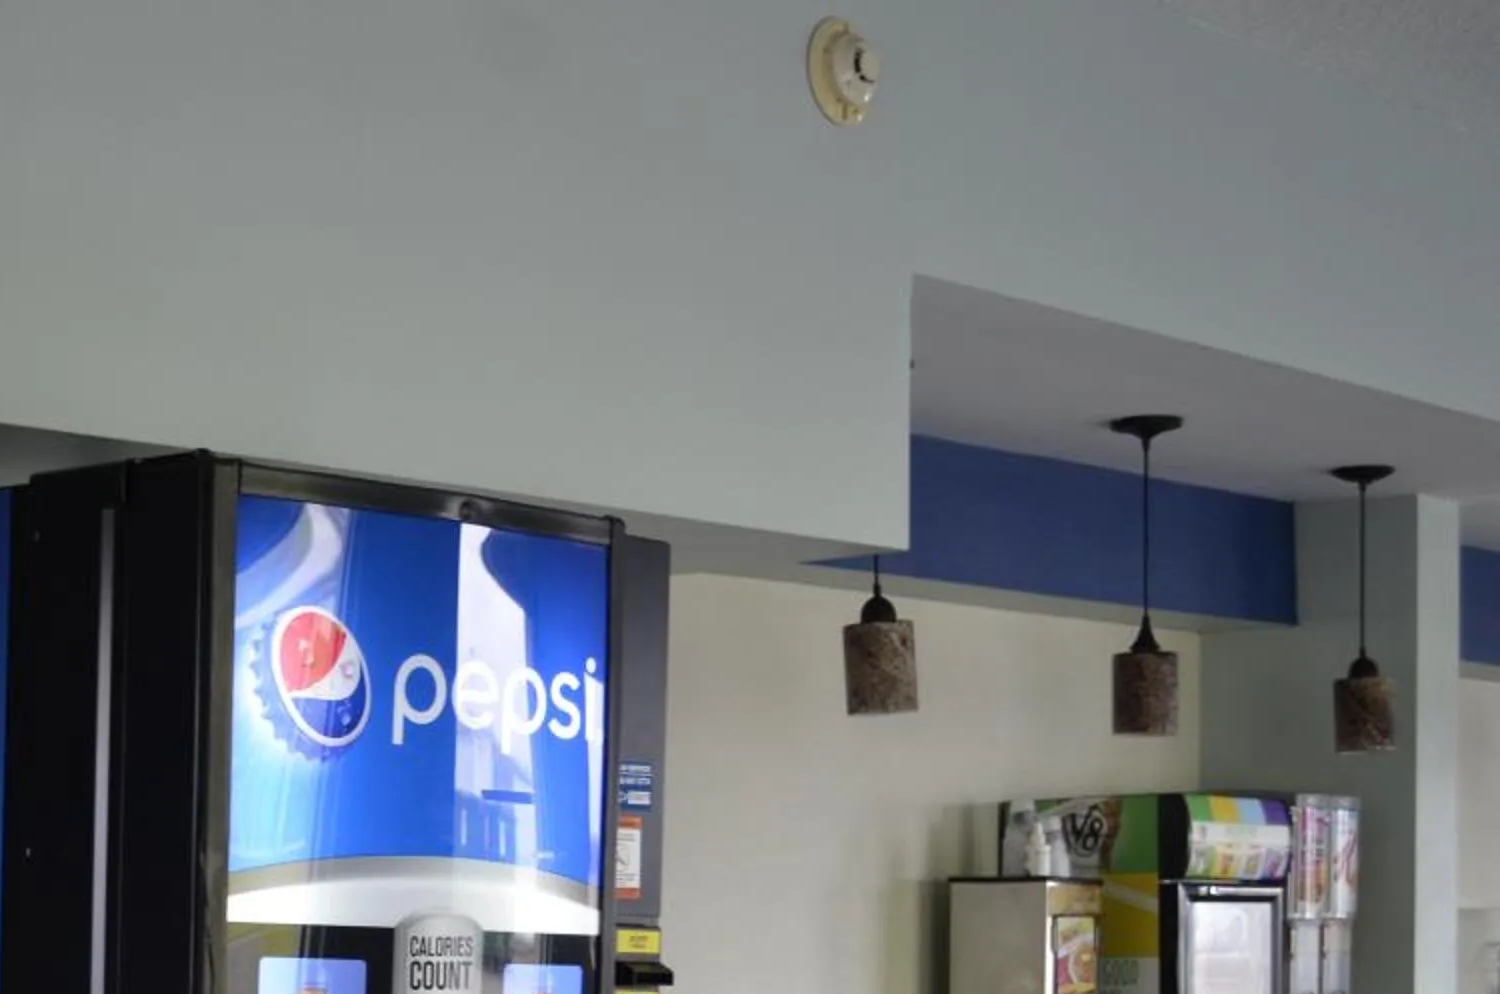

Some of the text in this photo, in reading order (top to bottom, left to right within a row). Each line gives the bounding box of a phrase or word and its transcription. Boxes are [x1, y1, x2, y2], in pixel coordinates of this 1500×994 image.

[392, 653, 604, 755] pepsi
[1069, 804, 1104, 852] V8
[409, 935, 474, 957] CALORIES
[409, 960, 473, 991] COUNT
